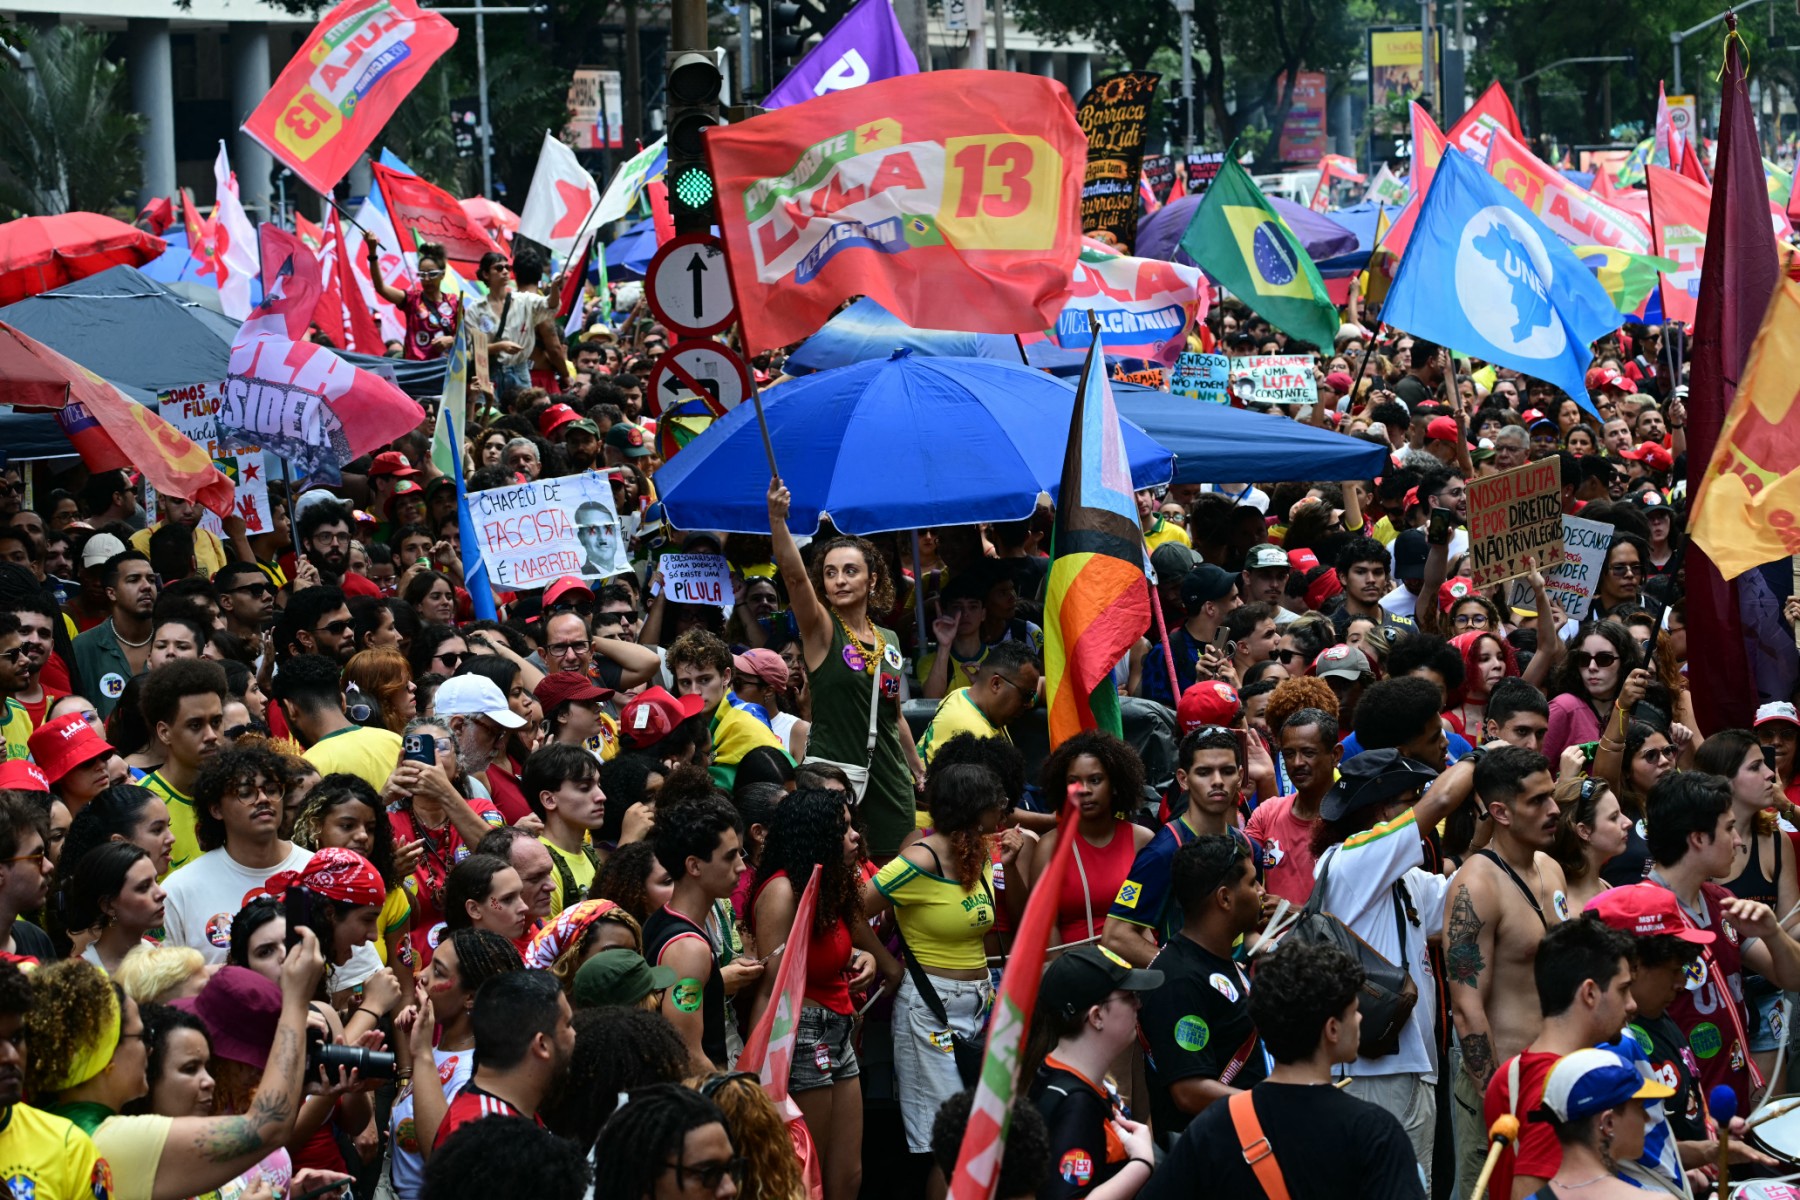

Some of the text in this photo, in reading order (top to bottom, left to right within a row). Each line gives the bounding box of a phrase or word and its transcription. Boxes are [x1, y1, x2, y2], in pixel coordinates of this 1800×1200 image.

[1078, 104, 1146, 132] Barraca
[1106, 122, 1140, 151] Lidi
[747, 134, 847, 212] PRESIDENTE
[757, 141, 1034, 267] LULA 13
[1059, 311, 1088, 335] VICE
[1214, 357, 1227, 368] DO
[1248, 356, 1311, 369] LIBERDADE
[1264, 367, 1288, 376] UMA
[1194, 380, 1224, 390] MOVEM
[1262, 373, 1306, 389] LUTA
[184, 398, 224, 419] FiLHO
[480, 484, 562, 516] CHAPÉU DE
[1468, 465, 1557, 514] NOSSA LUTA
[484, 508, 574, 554] FASCISTA
[1471, 511, 1481, 540] É
[1483, 507, 1508, 537] POR
[1562, 525, 1612, 551] DESCANSO
[1473, 534, 1505, 569] NÃO
[497, 551, 582, 585] É MARRETA
[668, 570, 679, 580] SÓ
[671, 562, 690, 570] UMA
[674, 579, 722, 602] PÍLULA
[106, 679, 123, 693] 13
[587, 735, 600, 750] 13
[1635, 922, 1666, 932] MARINA
[1638, 914, 1656, 924] MST
